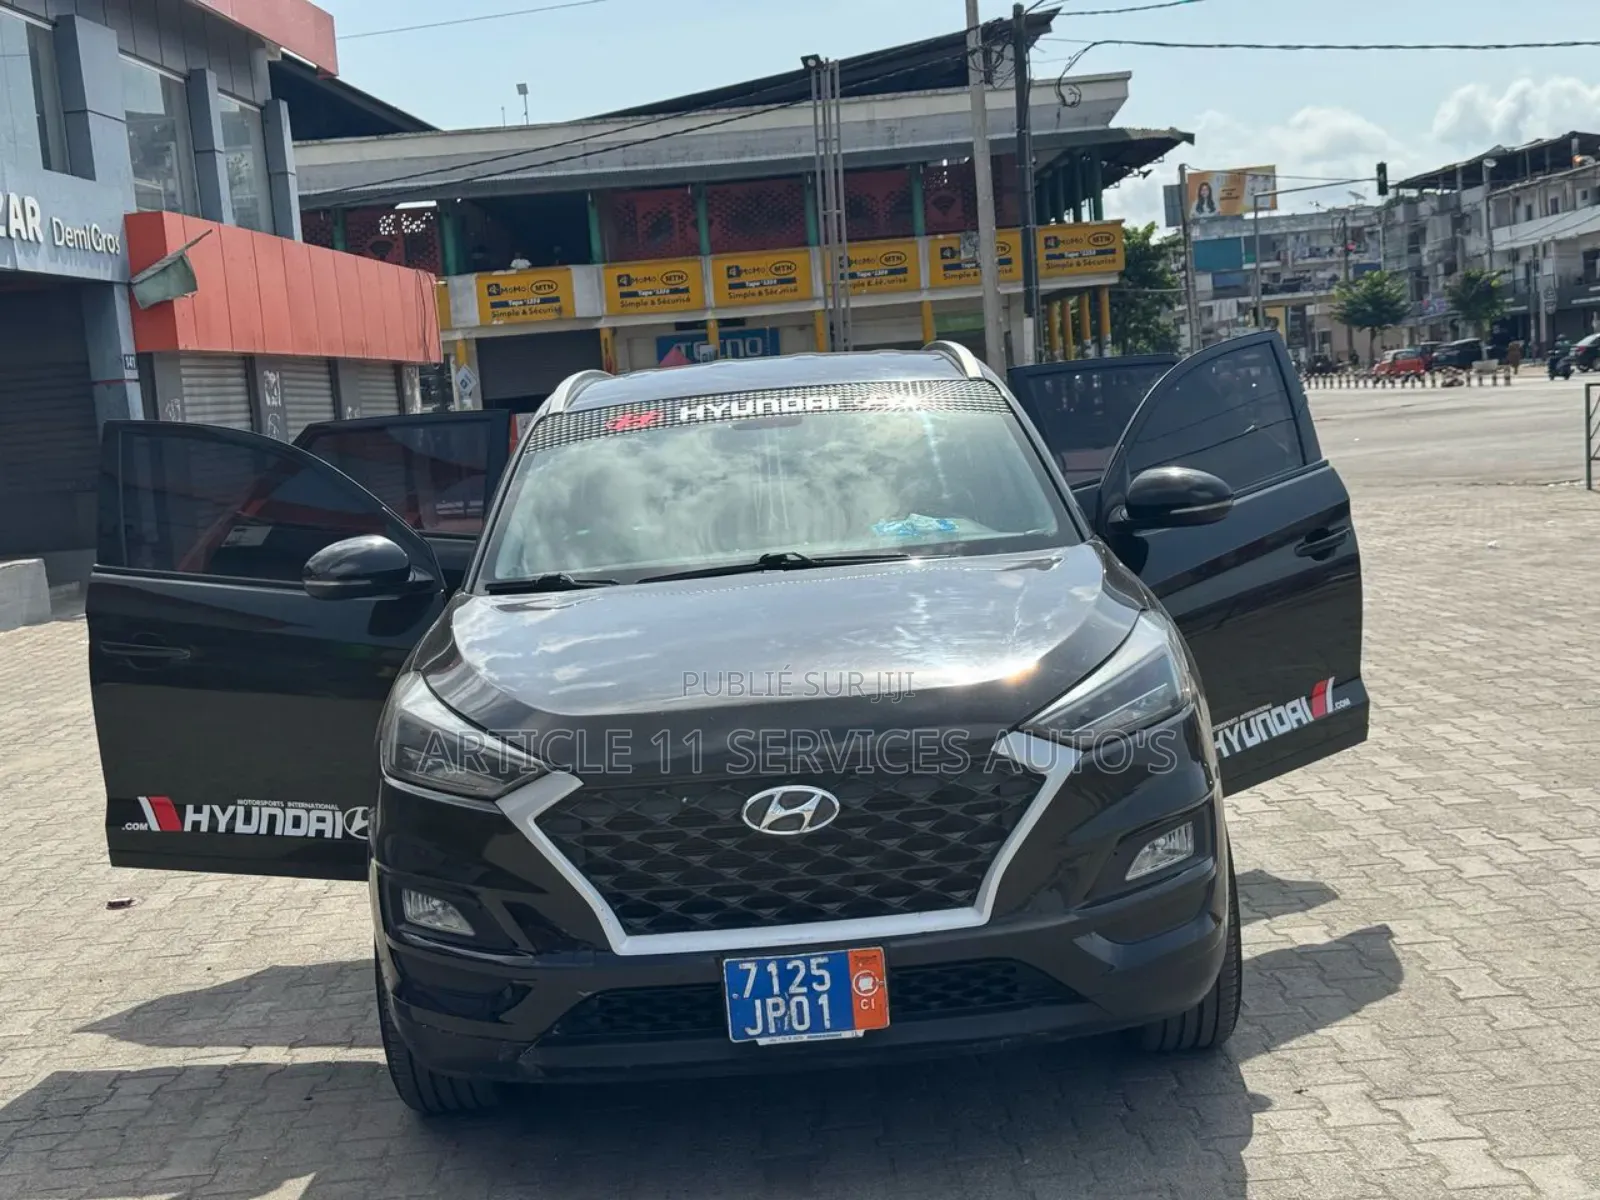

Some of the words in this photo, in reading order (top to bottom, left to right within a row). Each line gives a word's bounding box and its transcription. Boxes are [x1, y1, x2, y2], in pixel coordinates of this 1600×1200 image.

[1092, 235, 1111, 243] MTN
[884, 254, 902, 263] MTN
[774, 264, 792, 273] MTN
[665, 273, 684, 283] MTN
[535, 283, 554, 292] MTN
[620, 300, 648, 309] Simple
[492, 309, 520, 319] Simple
[680, 396, 839, 421] HYUNDAI
[1213, 696, 1314, 758] HYUNDAI
[237, 799, 285, 808] MOTORSPORTS
[287, 801, 340, 811] INTERNATIONAL
[121, 823, 149, 831] .COM
[184, 804, 343, 840] HYUNDAI
[739, 957, 831, 999] 7125
[860, 998, 876, 1010] CI
